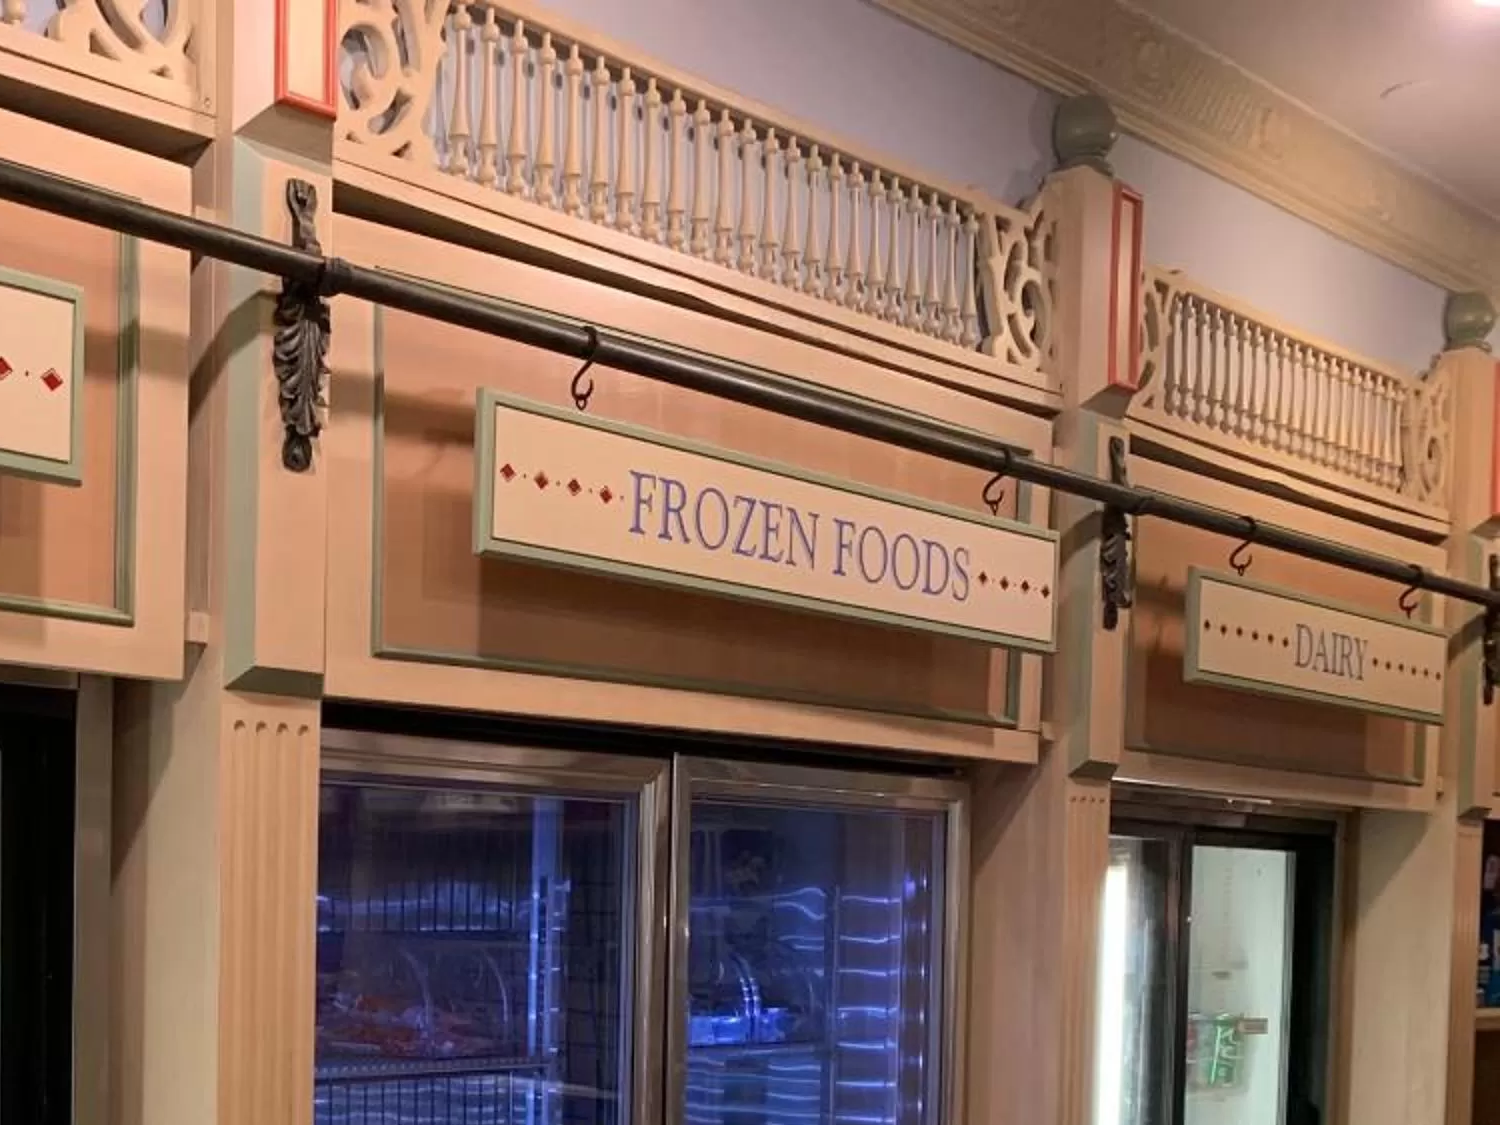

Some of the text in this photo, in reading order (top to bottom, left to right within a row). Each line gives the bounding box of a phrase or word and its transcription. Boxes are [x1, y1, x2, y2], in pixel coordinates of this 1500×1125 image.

[628, 468, 972, 602] FROZEN FOODS
[1294, 622, 1369, 682] DAIRY
